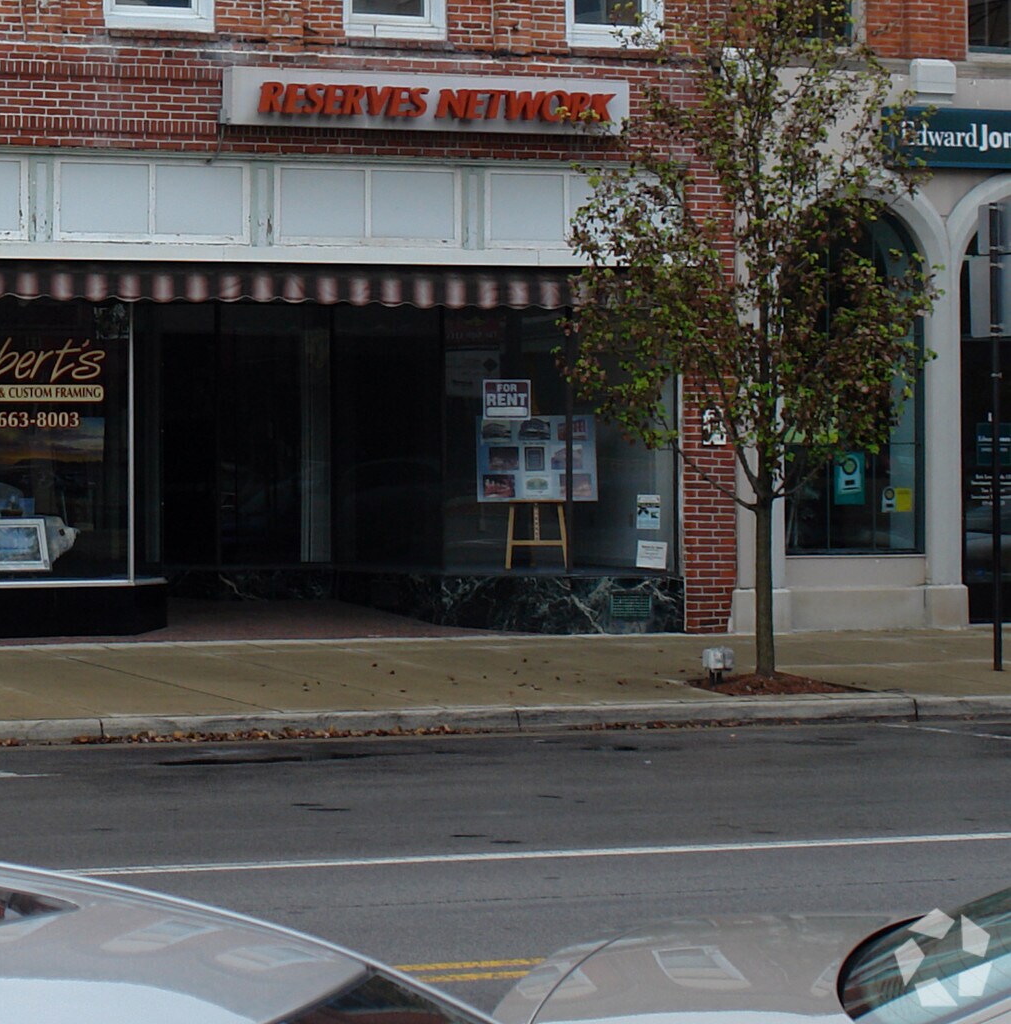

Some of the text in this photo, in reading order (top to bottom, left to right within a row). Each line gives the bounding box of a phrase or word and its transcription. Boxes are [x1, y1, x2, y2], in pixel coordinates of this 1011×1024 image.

[257, 81, 617, 123] RESERVES NETWORK
[8, 386, 52, 399] CUSTOM
[55, 386, 102, 399] FRAMING
[496, 383, 517, 393] FOR
[486, 393, 527, 407] RENT
